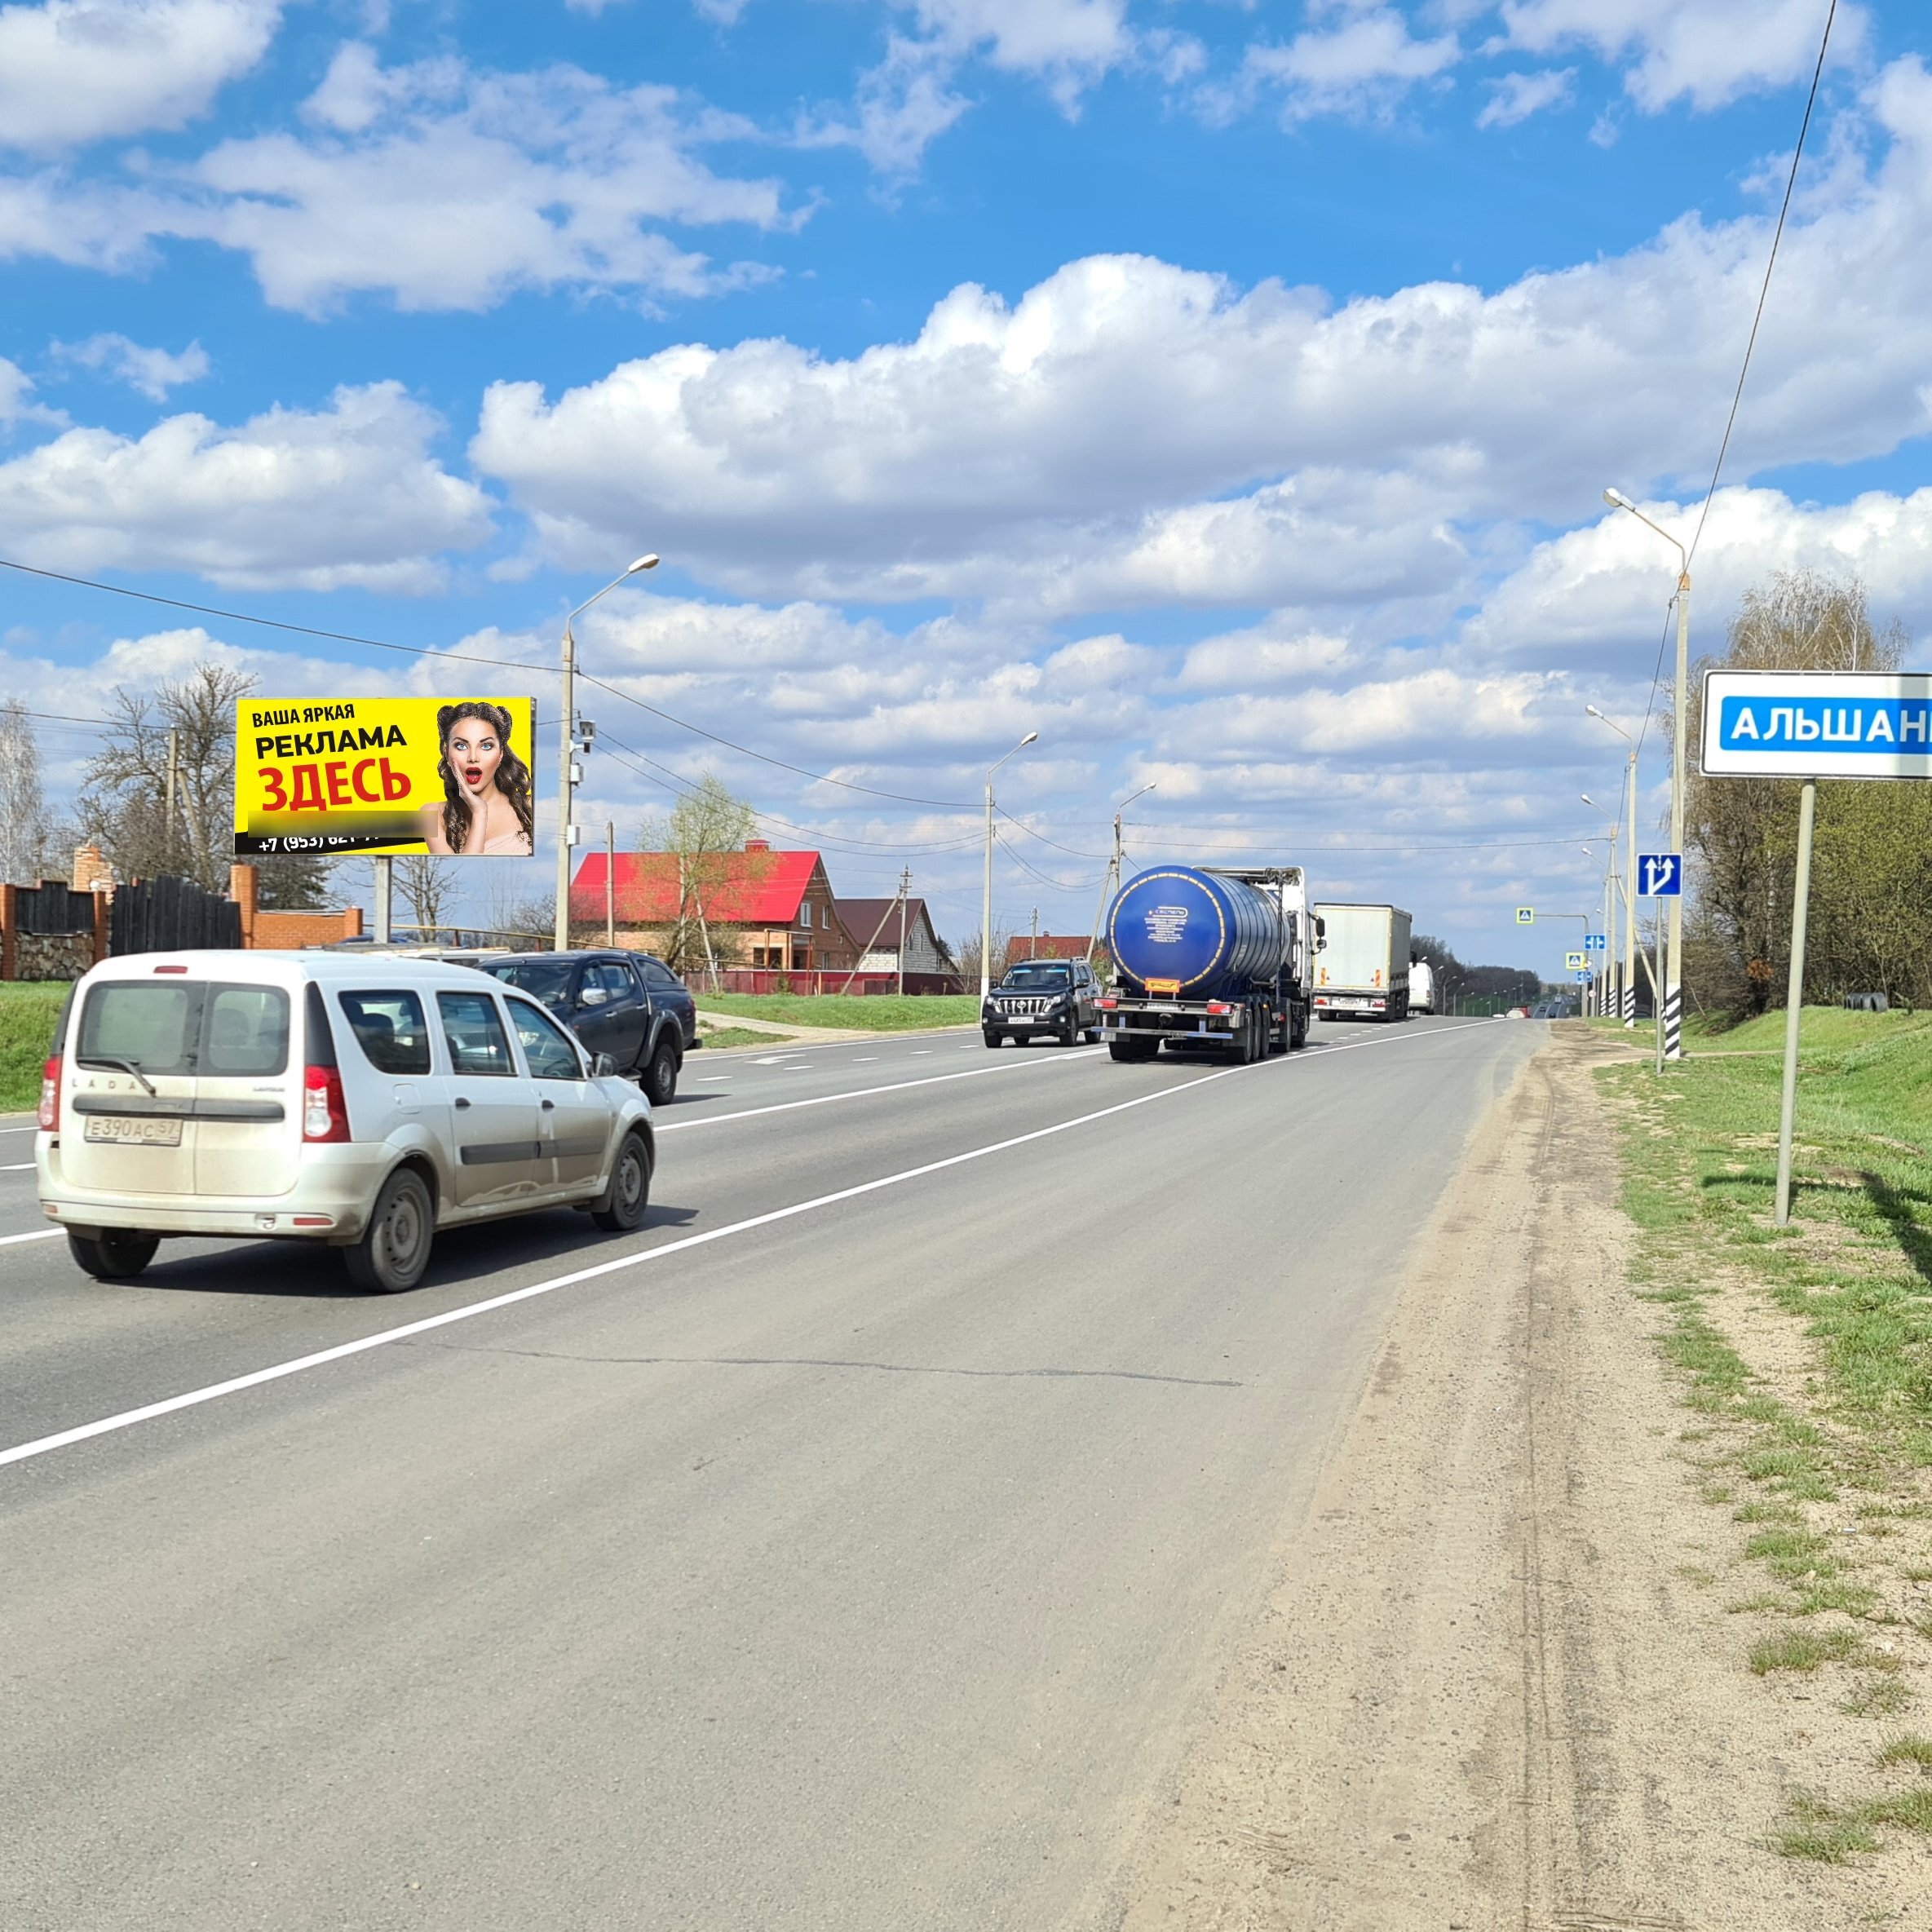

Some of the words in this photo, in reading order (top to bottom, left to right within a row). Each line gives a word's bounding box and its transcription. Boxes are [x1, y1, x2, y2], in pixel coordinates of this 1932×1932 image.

[252, 709, 300, 727] ВАША
[303, 704, 355, 723] ЯРКАЯ
[1731, 707, 1932, 742] АЛЬШАН
[255, 724, 407, 759] РЕКЛАМА
[258, 758, 411, 811] ЗДЕСЬ
[259, 838, 277, 851] +7
[283, 838, 324, 852] (953)
[72, 1078, 136, 1090] LADA
